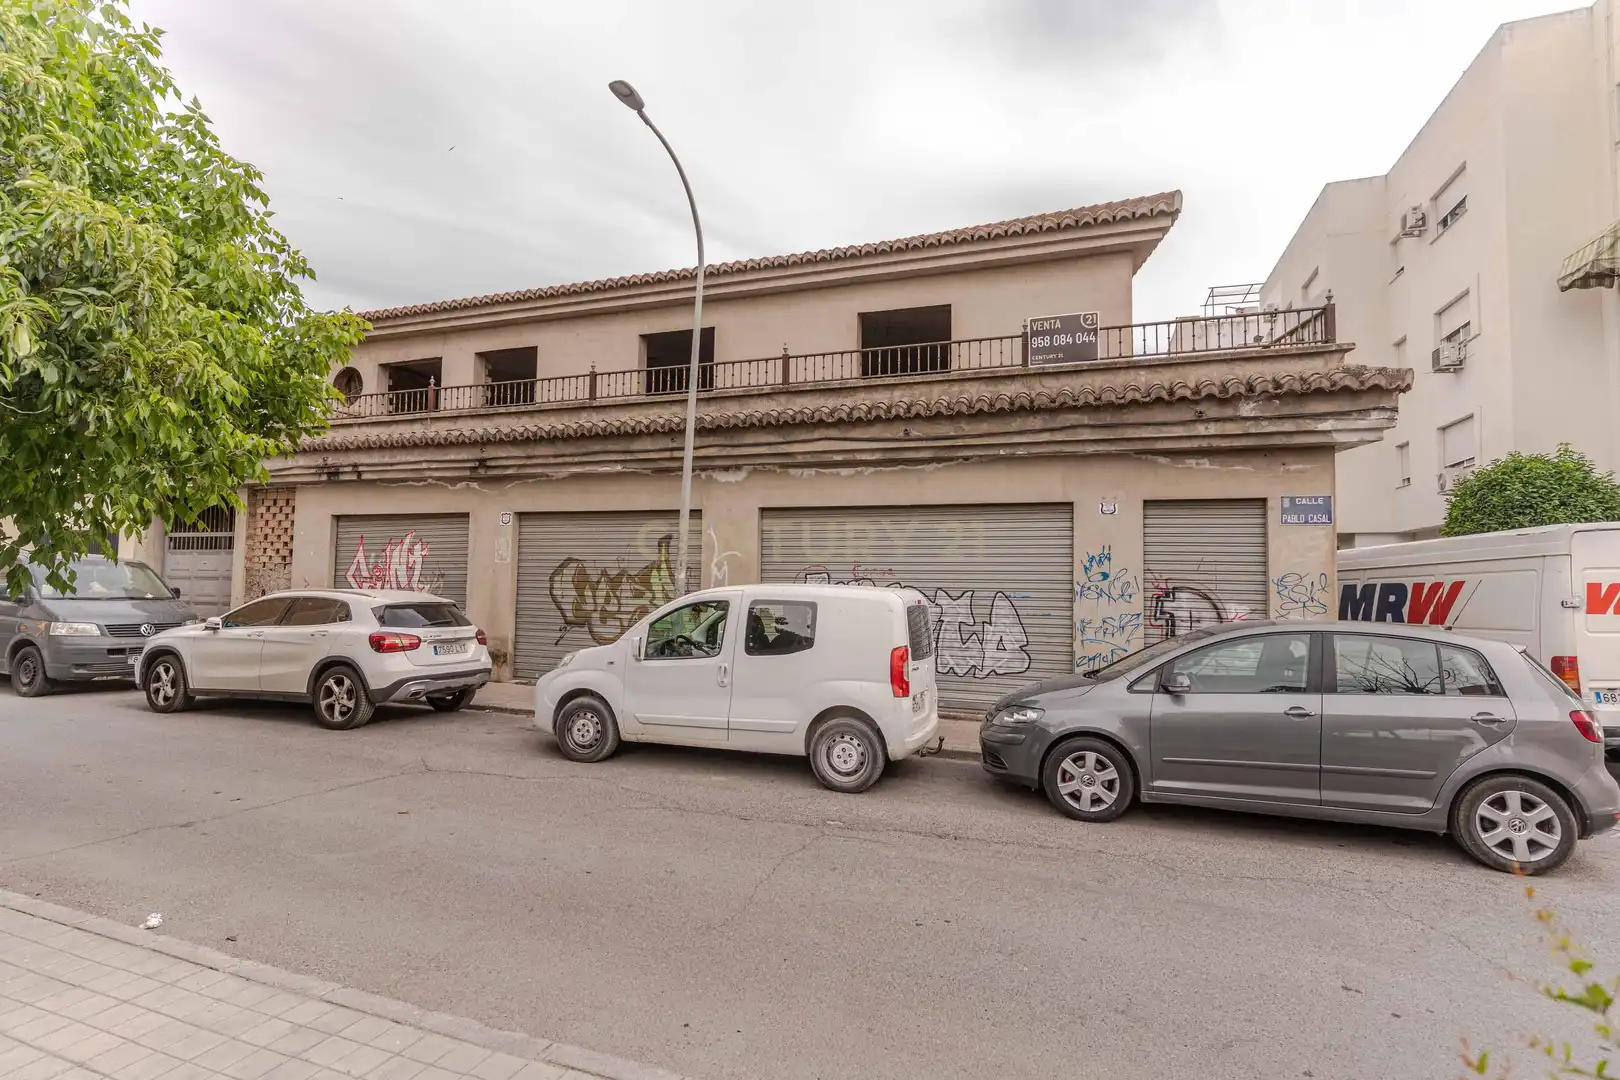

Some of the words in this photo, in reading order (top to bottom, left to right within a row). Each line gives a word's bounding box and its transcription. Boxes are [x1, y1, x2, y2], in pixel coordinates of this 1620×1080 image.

[1032, 319, 1060, 330] VENTA
[1086, 314, 1096, 324] 21
[1032, 336, 1050, 347] 958
[1053, 334, 1072, 345] 084
[1076, 332, 1095, 343] 044
[1283, 514, 1304, 523] PABLO
[1308, 514, 1330, 523] CASAL
[1338, 580, 1466, 625] MRW
